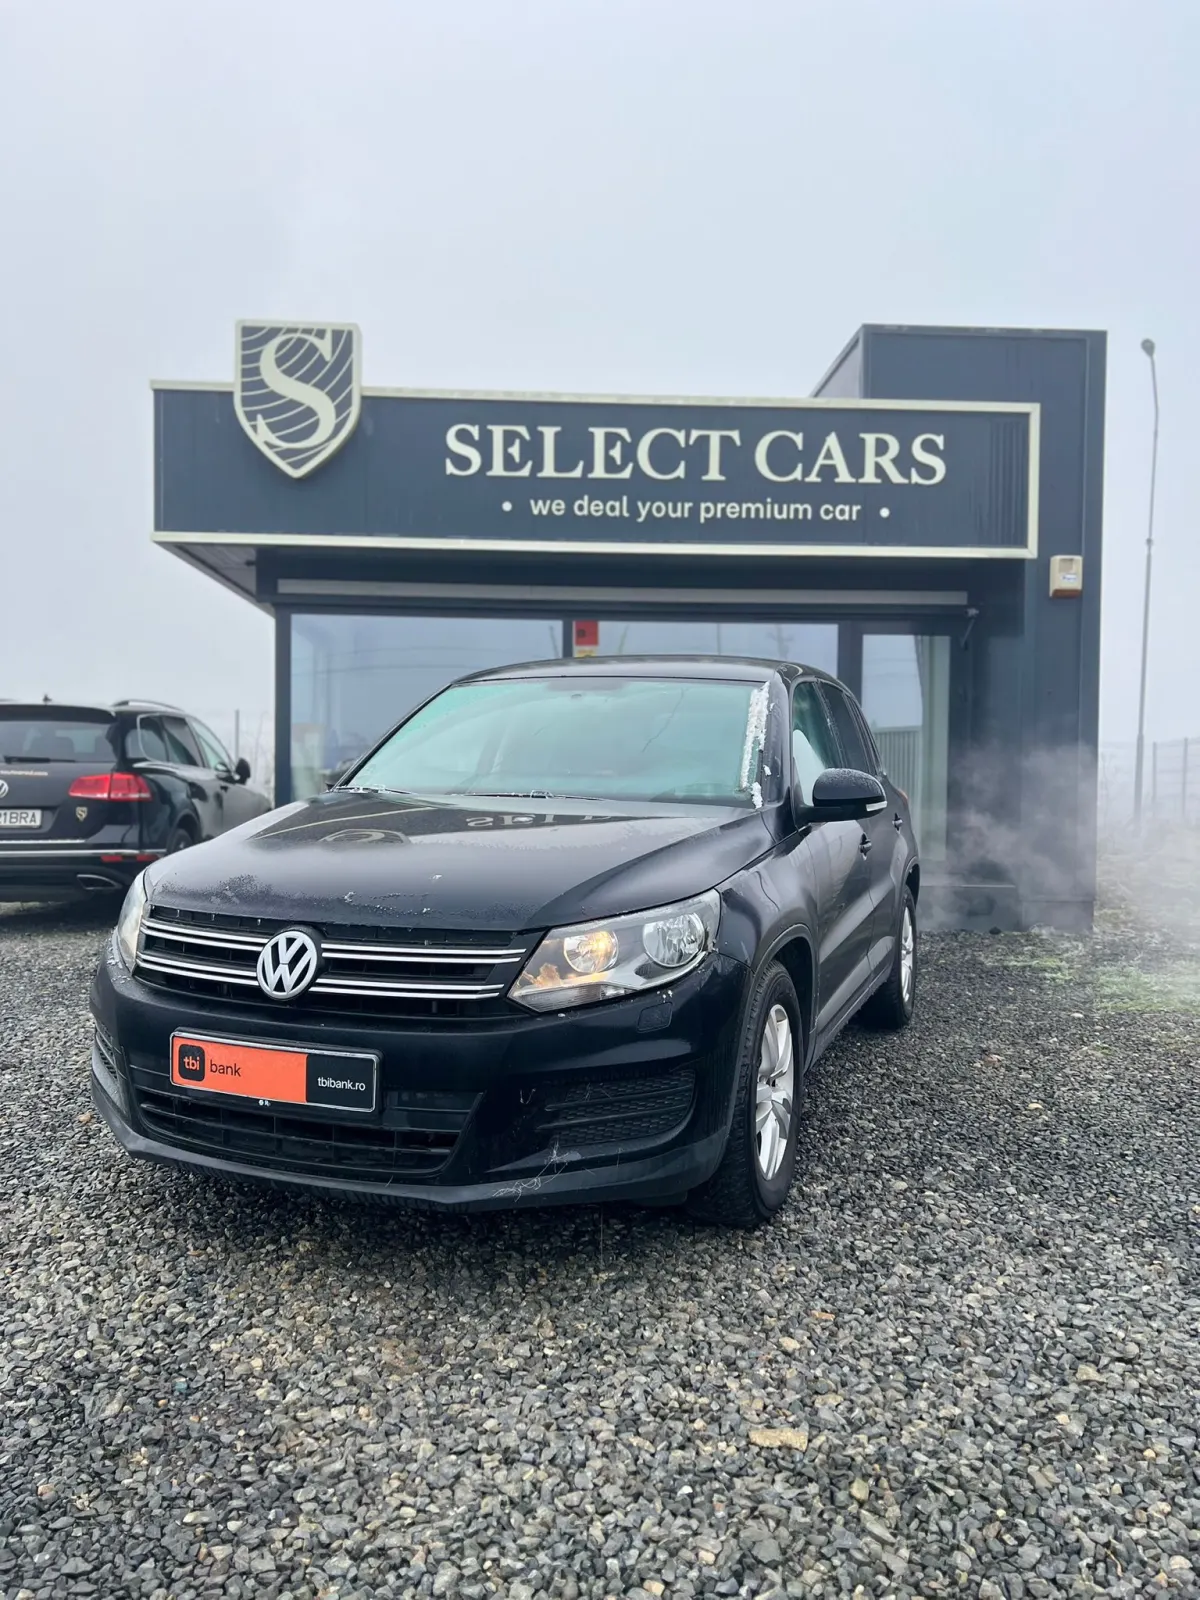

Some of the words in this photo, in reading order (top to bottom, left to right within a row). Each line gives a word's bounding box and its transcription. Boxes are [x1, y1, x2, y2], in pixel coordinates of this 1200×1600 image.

[257, 330, 337, 449] S
[445, 423, 741, 481] SELECT
[754, 430, 947, 485] CARS
[529, 499, 566, 516] we
[573, 495, 630, 517] deal
[636, 501, 693, 523] your
[700, 498, 812, 523] premium
[819, 504, 861, 521] car
[0, 811, 37, 824] 1BRA
[183, 1055, 200, 1071] tbi
[209, 1059, 242, 1077] bank
[317, 1076, 366, 1092] tbibank.ro
